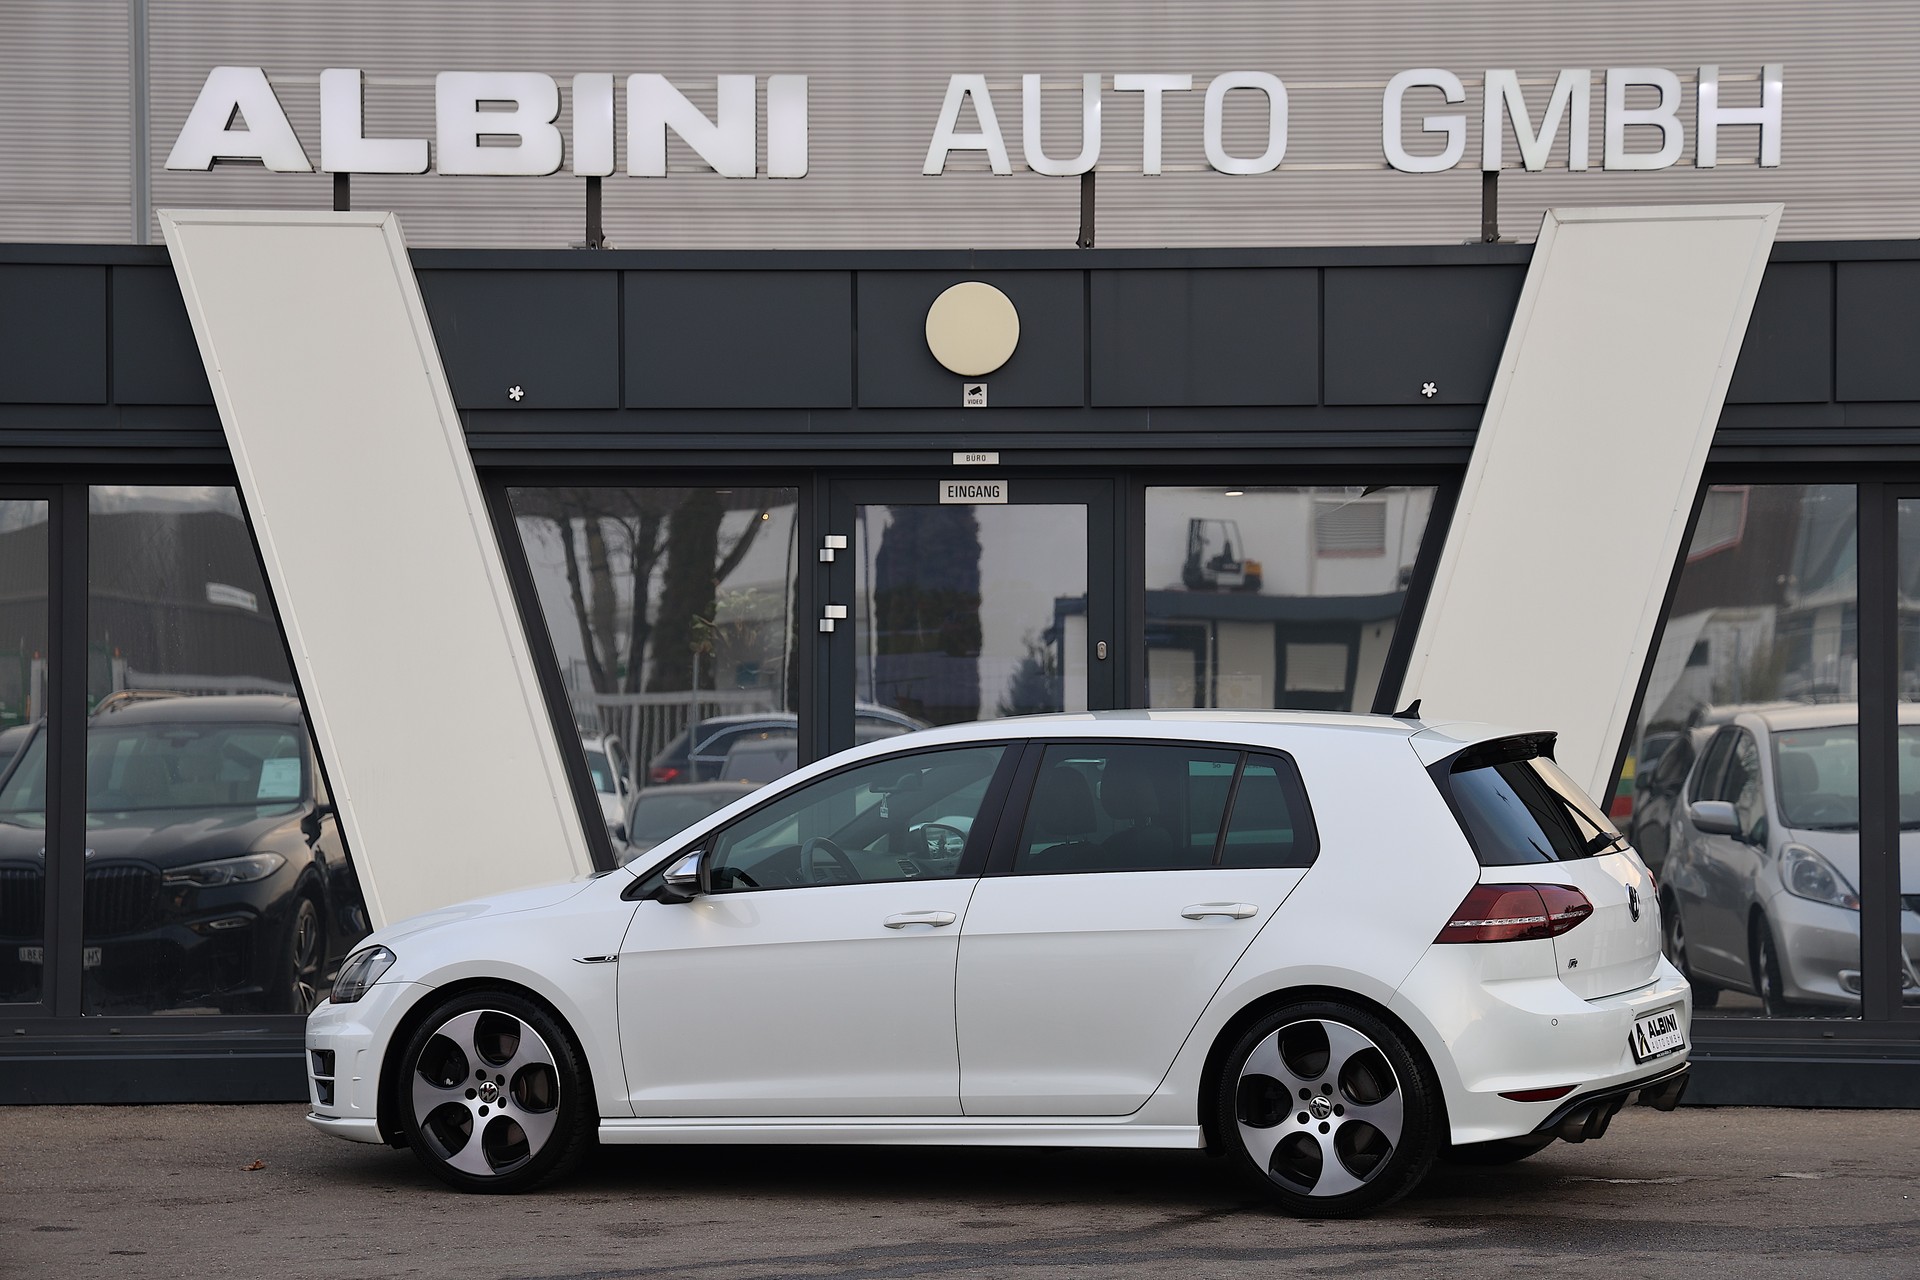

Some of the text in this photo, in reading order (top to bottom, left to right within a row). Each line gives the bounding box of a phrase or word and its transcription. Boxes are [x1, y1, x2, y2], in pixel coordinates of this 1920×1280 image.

[164, 64, 1784, 178] ALBINI AUTO GMBH
[966, 453, 987, 462] BÜRO
[947, 485, 1000, 498] EINGANG
[1648, 1013, 1677, 1038] ALBINI
